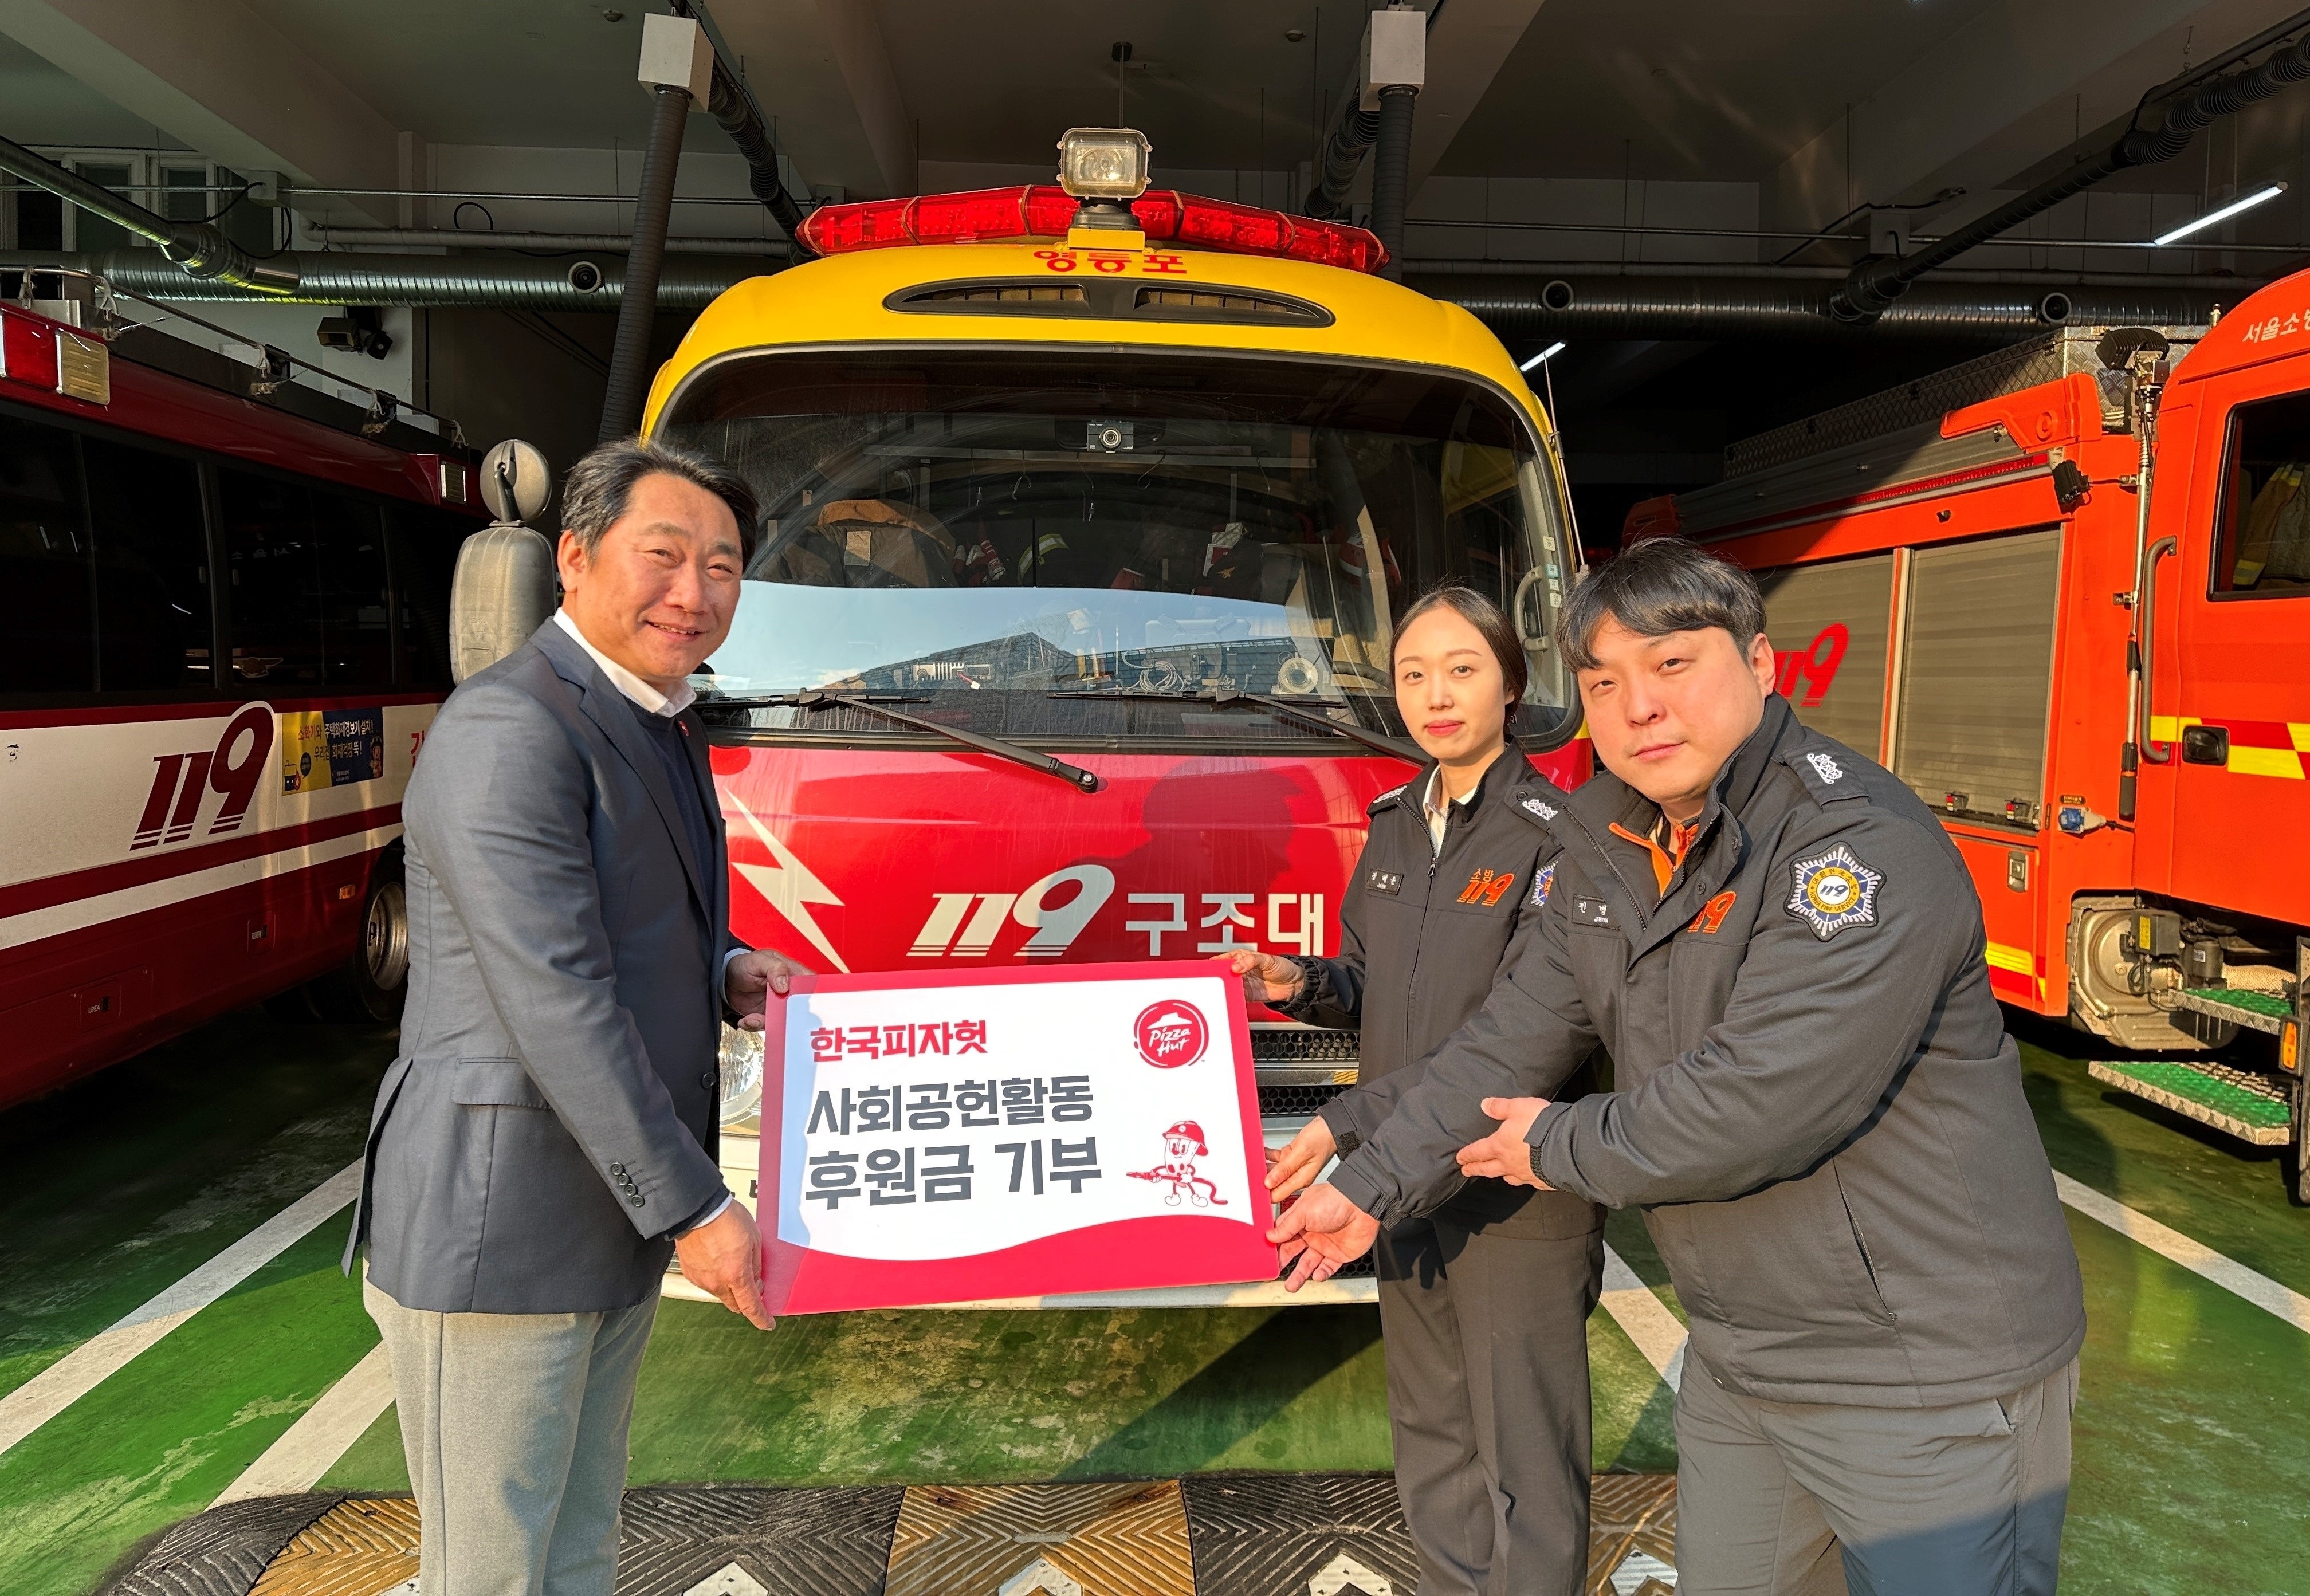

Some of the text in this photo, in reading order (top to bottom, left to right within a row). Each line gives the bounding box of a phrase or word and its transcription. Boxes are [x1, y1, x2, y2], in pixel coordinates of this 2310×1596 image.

[1033, 250, 1187, 273] 영등포
[298, 724, 322, 741] 소화기와
[324, 720, 360, 740] 주택화재경보기
[314, 745, 330, 762] 우리집
[332, 741, 353, 759] 화재걱정
[129, 706, 275, 851] 119
[1472, 868, 1494, 882] 소방
[1812, 868, 1858, 890] 대한민국소방
[1456, 873, 1515, 907] 119
[1819, 884, 1849, 897] 119
[906, 864, 1324, 957] 119 구조대
[1687, 891, 1737, 934] 19
[1809, 891, 1856, 912] KOREA FIRE SERVICE
[810, 1019, 988, 1063] 한국피자헛
[1149, 1027, 1191, 1048] Pizza
[1156, 1037, 1191, 1058] Hut
[807, 1075, 1094, 1136] 사회공헌활동
[805, 1137, 1102, 1210] 후원금 기부
